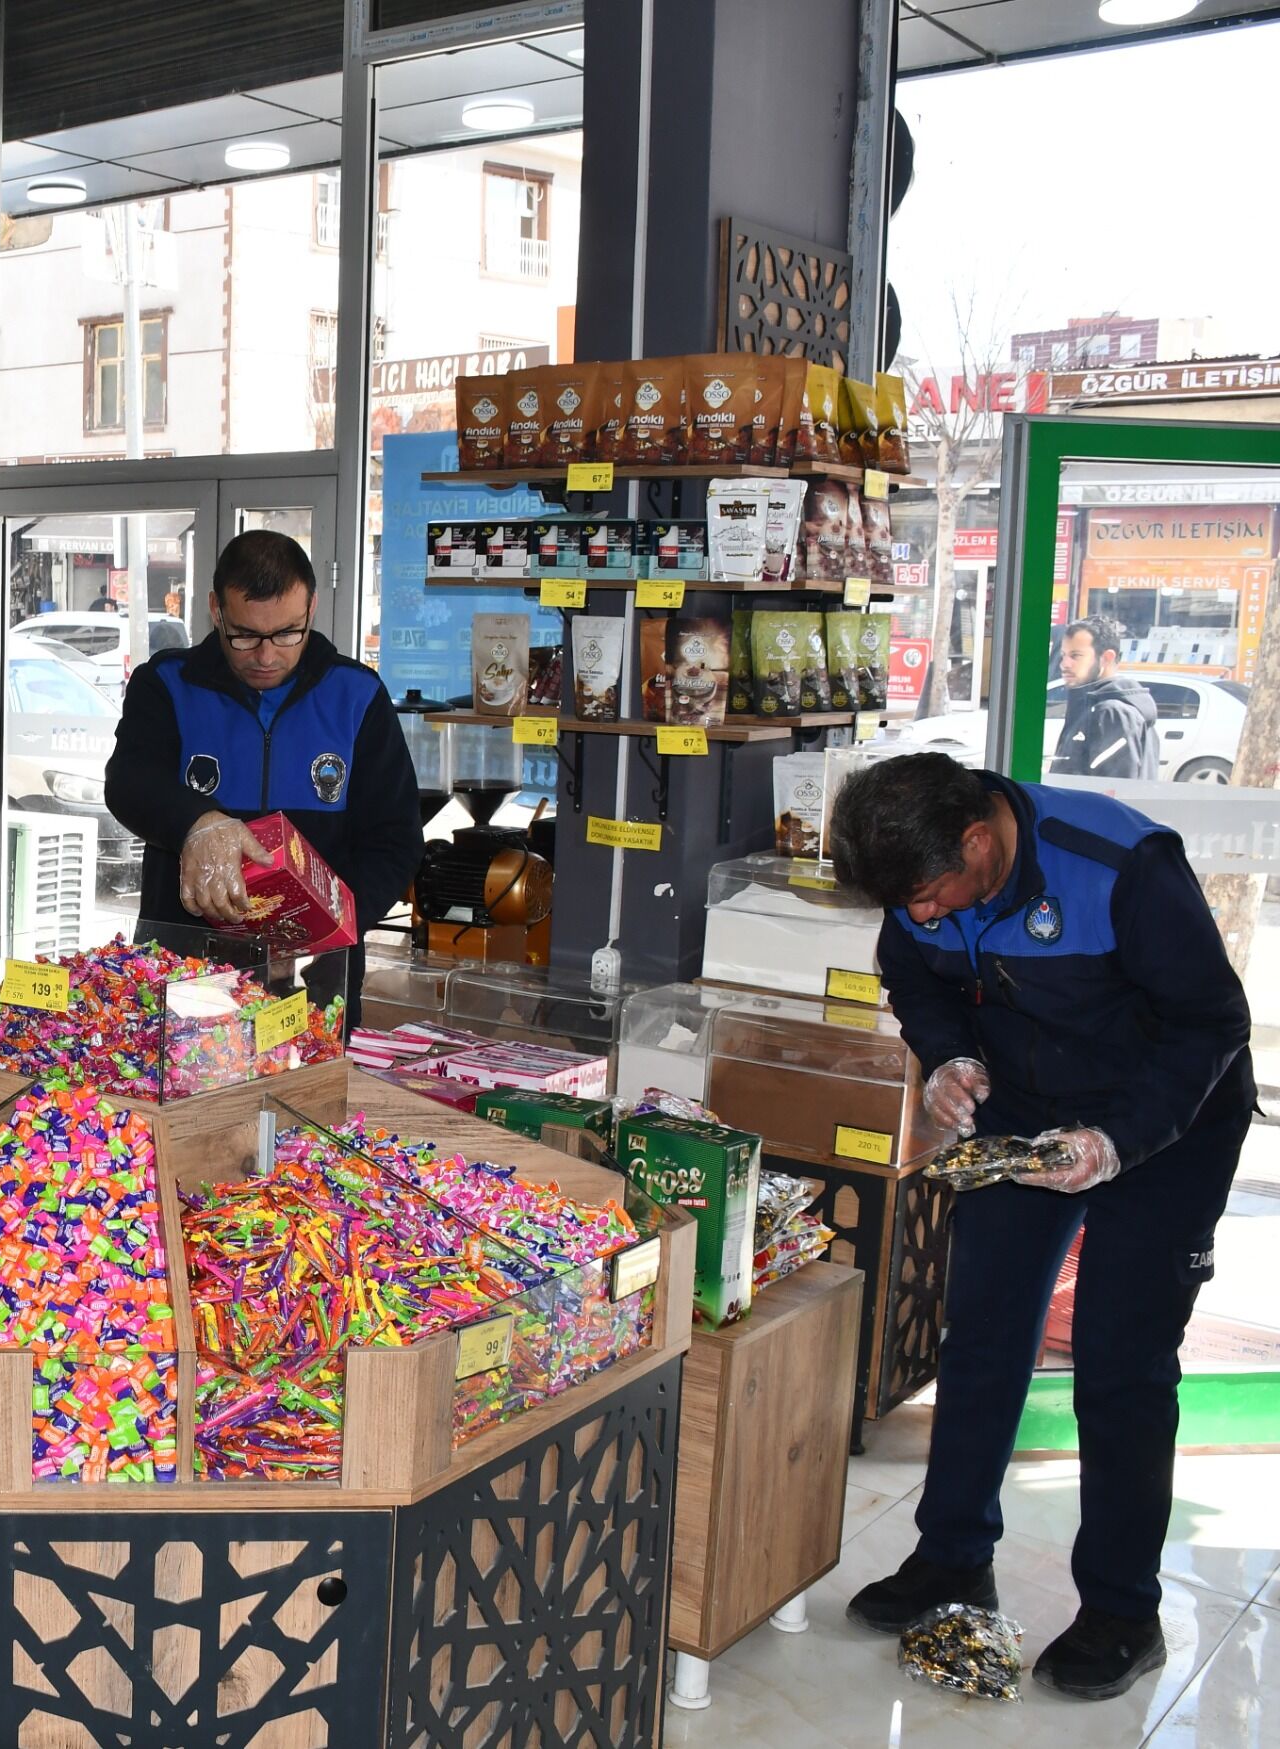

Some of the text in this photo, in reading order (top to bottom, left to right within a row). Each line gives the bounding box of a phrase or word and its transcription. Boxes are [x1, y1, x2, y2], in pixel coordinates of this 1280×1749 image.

[1082, 370, 1168, 394] ÖZGÜR
[909, 372, 1017, 415] ANE
[592, 475, 602, 483] 67
[1108, 574, 1231, 588] TEKNİK SERVİS
[537, 729, 547, 737] 67
[683, 738, 694, 747] 67
[31, 981, 51, 996] 139
[280, 1013, 296, 1030] 139
[858, 1140, 872, 1149] 220
[485, 1340, 499, 1356] 99
